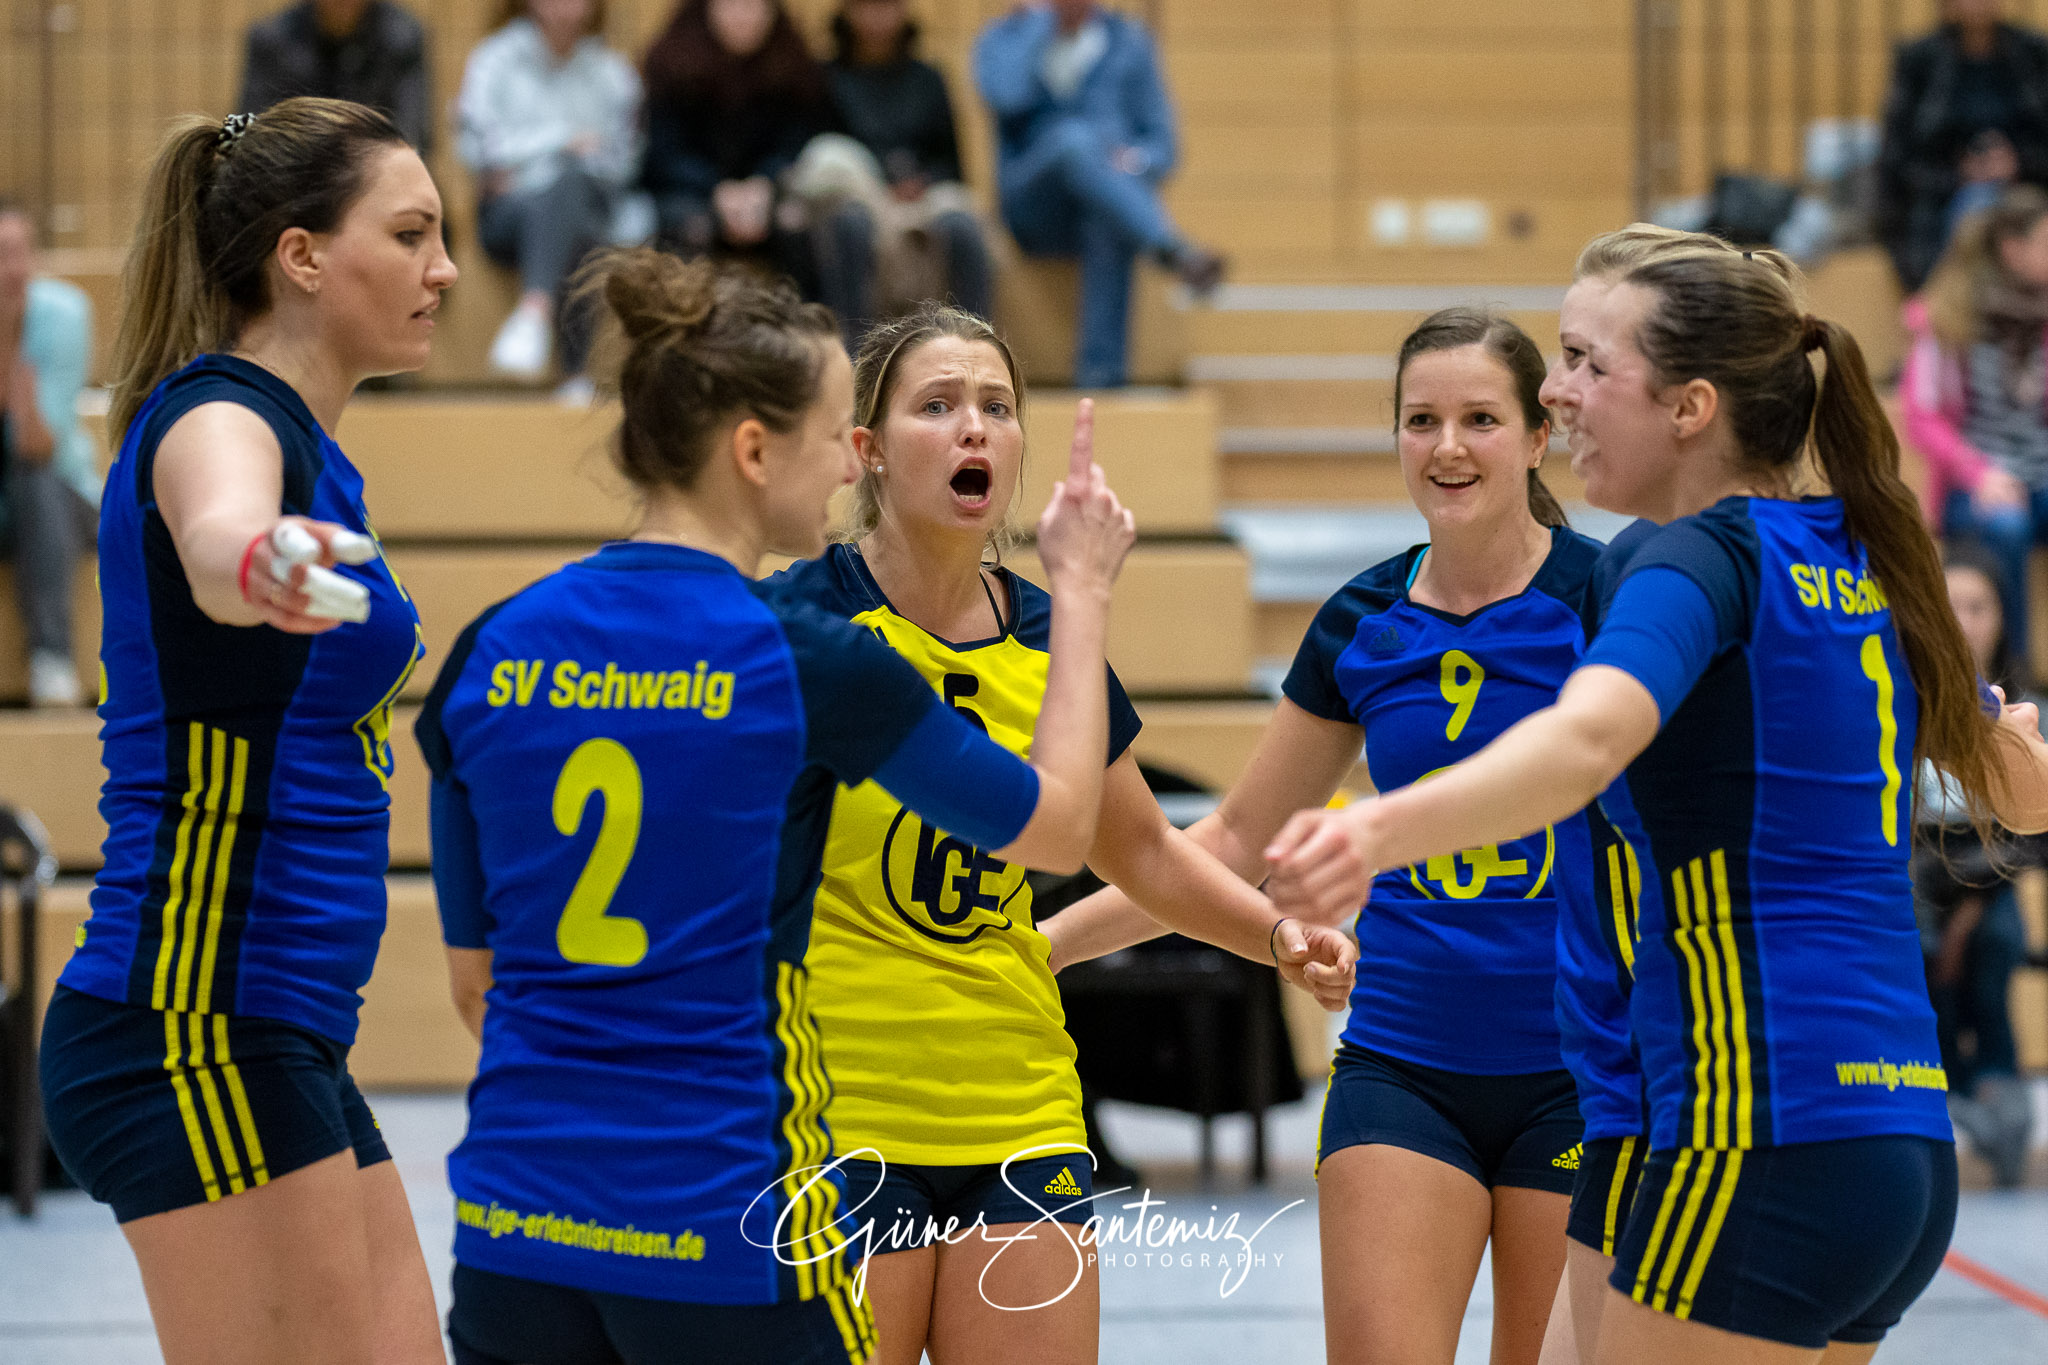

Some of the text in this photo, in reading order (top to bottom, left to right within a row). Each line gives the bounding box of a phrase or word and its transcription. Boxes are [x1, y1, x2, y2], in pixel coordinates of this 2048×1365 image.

[1790, 563, 1832, 610] SV
[487, 659, 736, 720] SV Schwaig
[1440, 649, 1486, 742] 9
[1860, 634, 1902, 847] 1
[551, 737, 649, 967] 2
[1044, 1183, 1083, 1196] adidas
